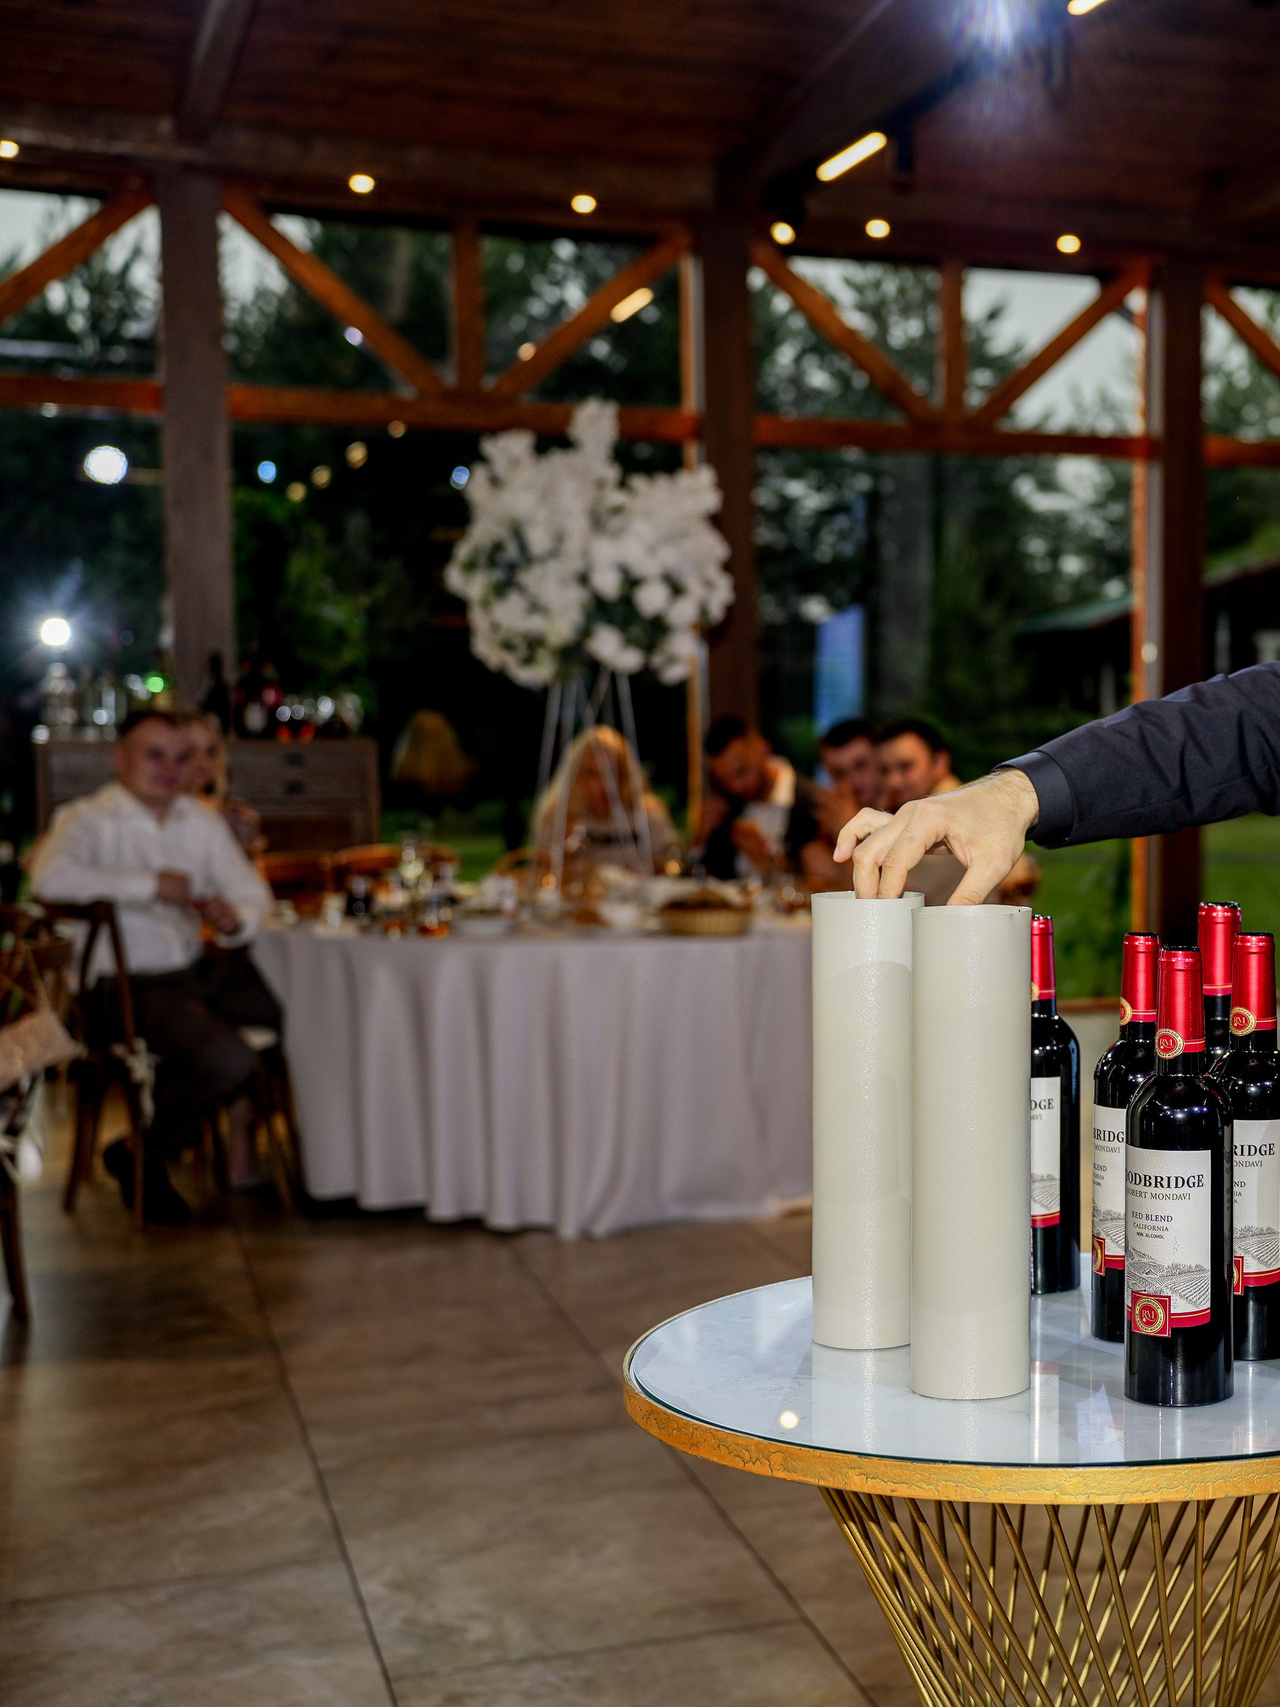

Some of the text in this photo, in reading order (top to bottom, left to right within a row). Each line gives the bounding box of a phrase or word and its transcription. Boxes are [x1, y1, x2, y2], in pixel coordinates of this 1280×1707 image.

[1150, 1192, 1191, 1201] MONDAVI
[1131, 1210, 1173, 1223] RED BLEND
[1132, 1221, 1169, 1232] CALIFORNIA
